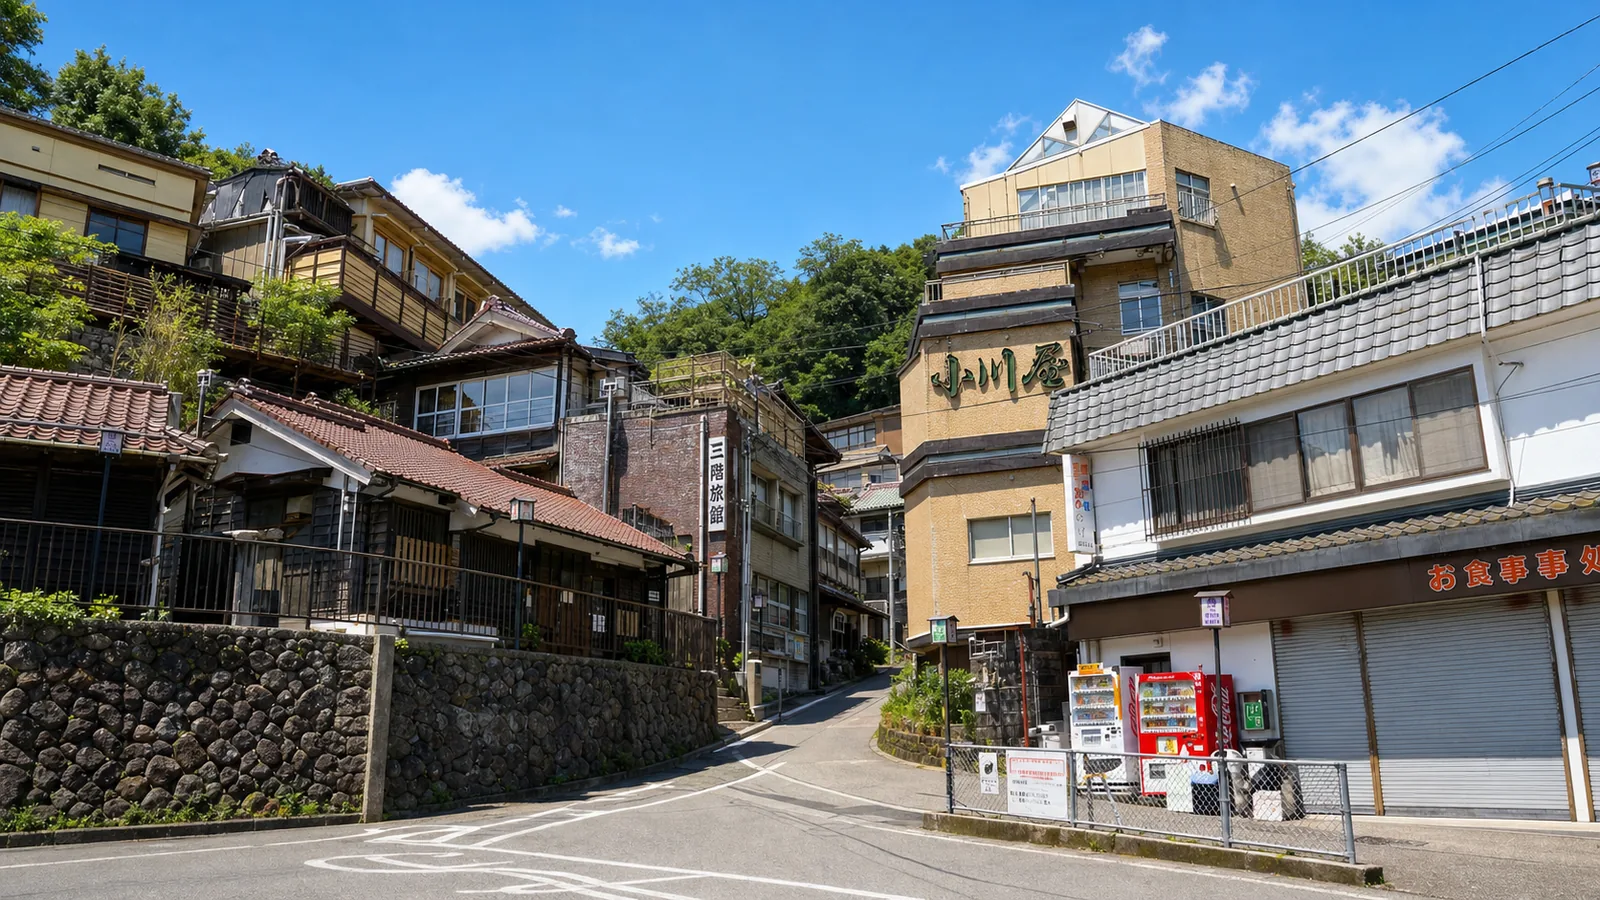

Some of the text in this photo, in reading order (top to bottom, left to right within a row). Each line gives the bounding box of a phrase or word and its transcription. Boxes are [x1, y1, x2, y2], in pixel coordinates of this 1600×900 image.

[931, 341, 1069, 398] 小川屋
[710, 441, 724, 525] 三階旅館
